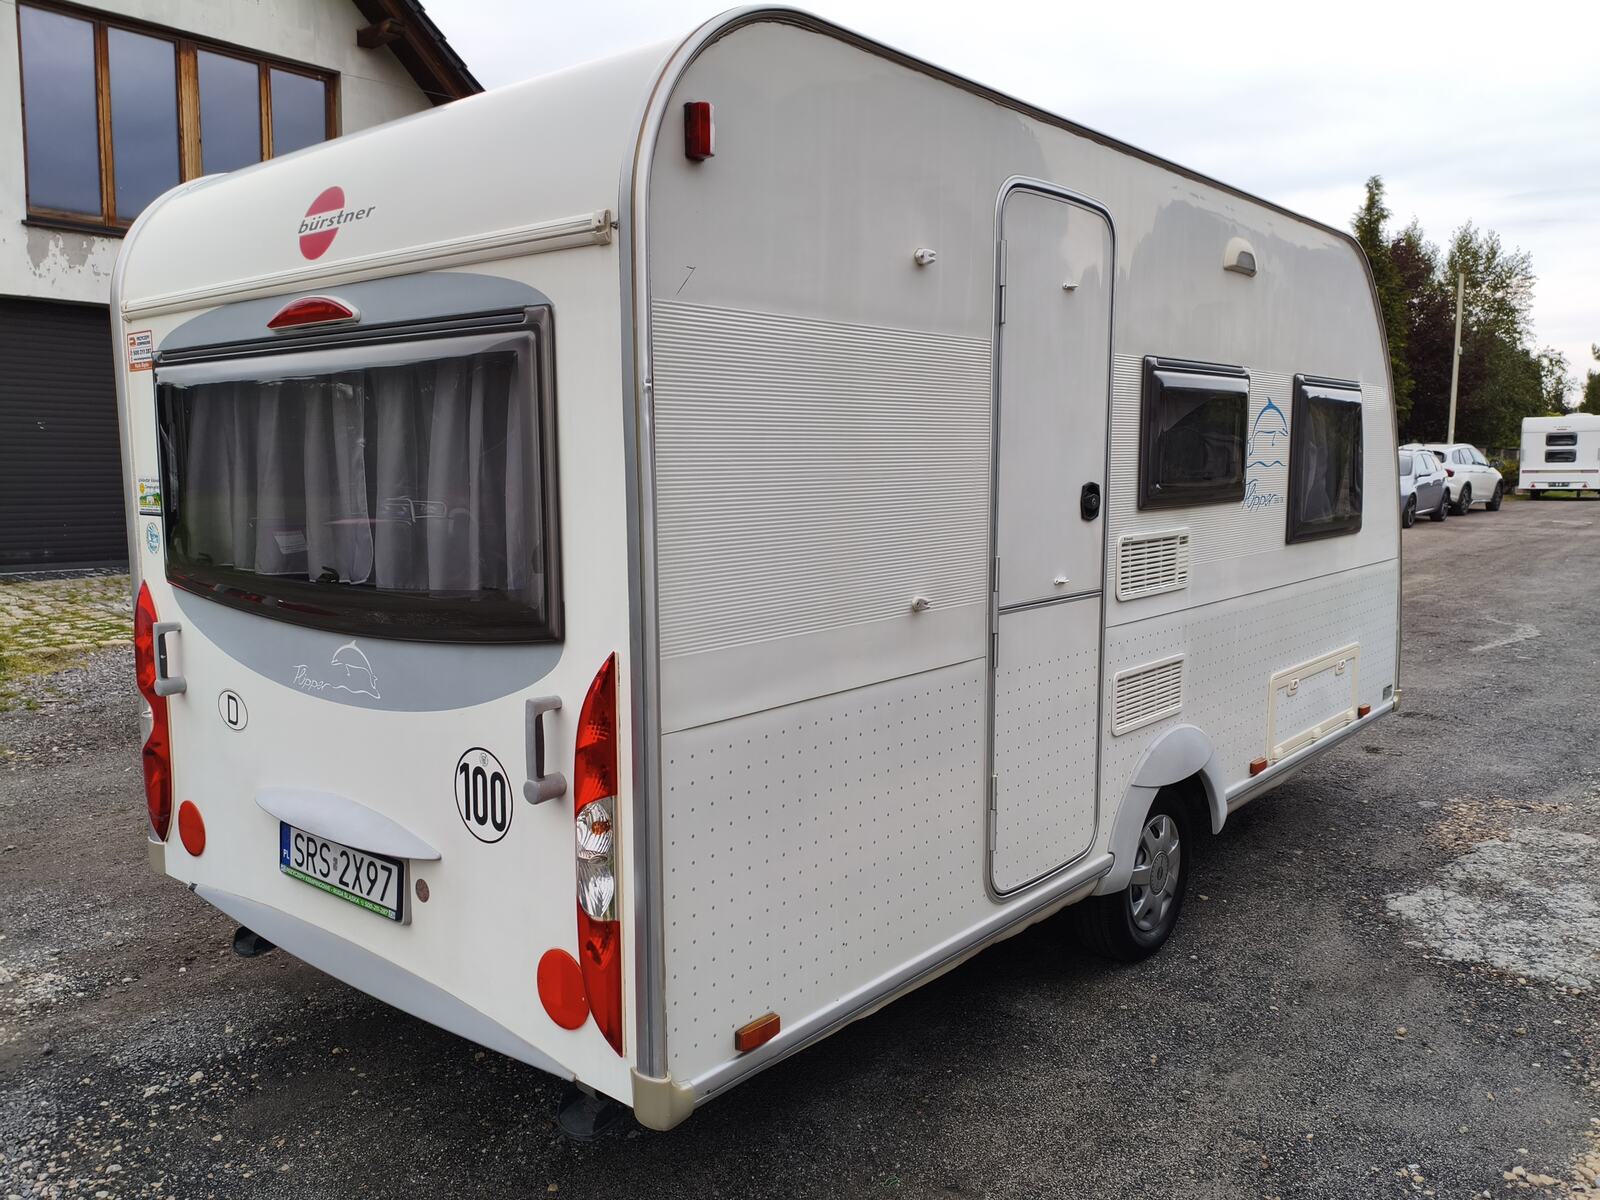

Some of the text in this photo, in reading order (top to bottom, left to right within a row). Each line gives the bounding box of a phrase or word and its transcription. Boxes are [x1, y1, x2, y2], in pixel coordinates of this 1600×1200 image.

[298, 206, 376, 234] bürstner
[227, 694, 239, 726] D
[459, 762, 507, 833] 100
[283, 848, 290, 860] PL
[294, 833, 393, 902] SRS 2X97
